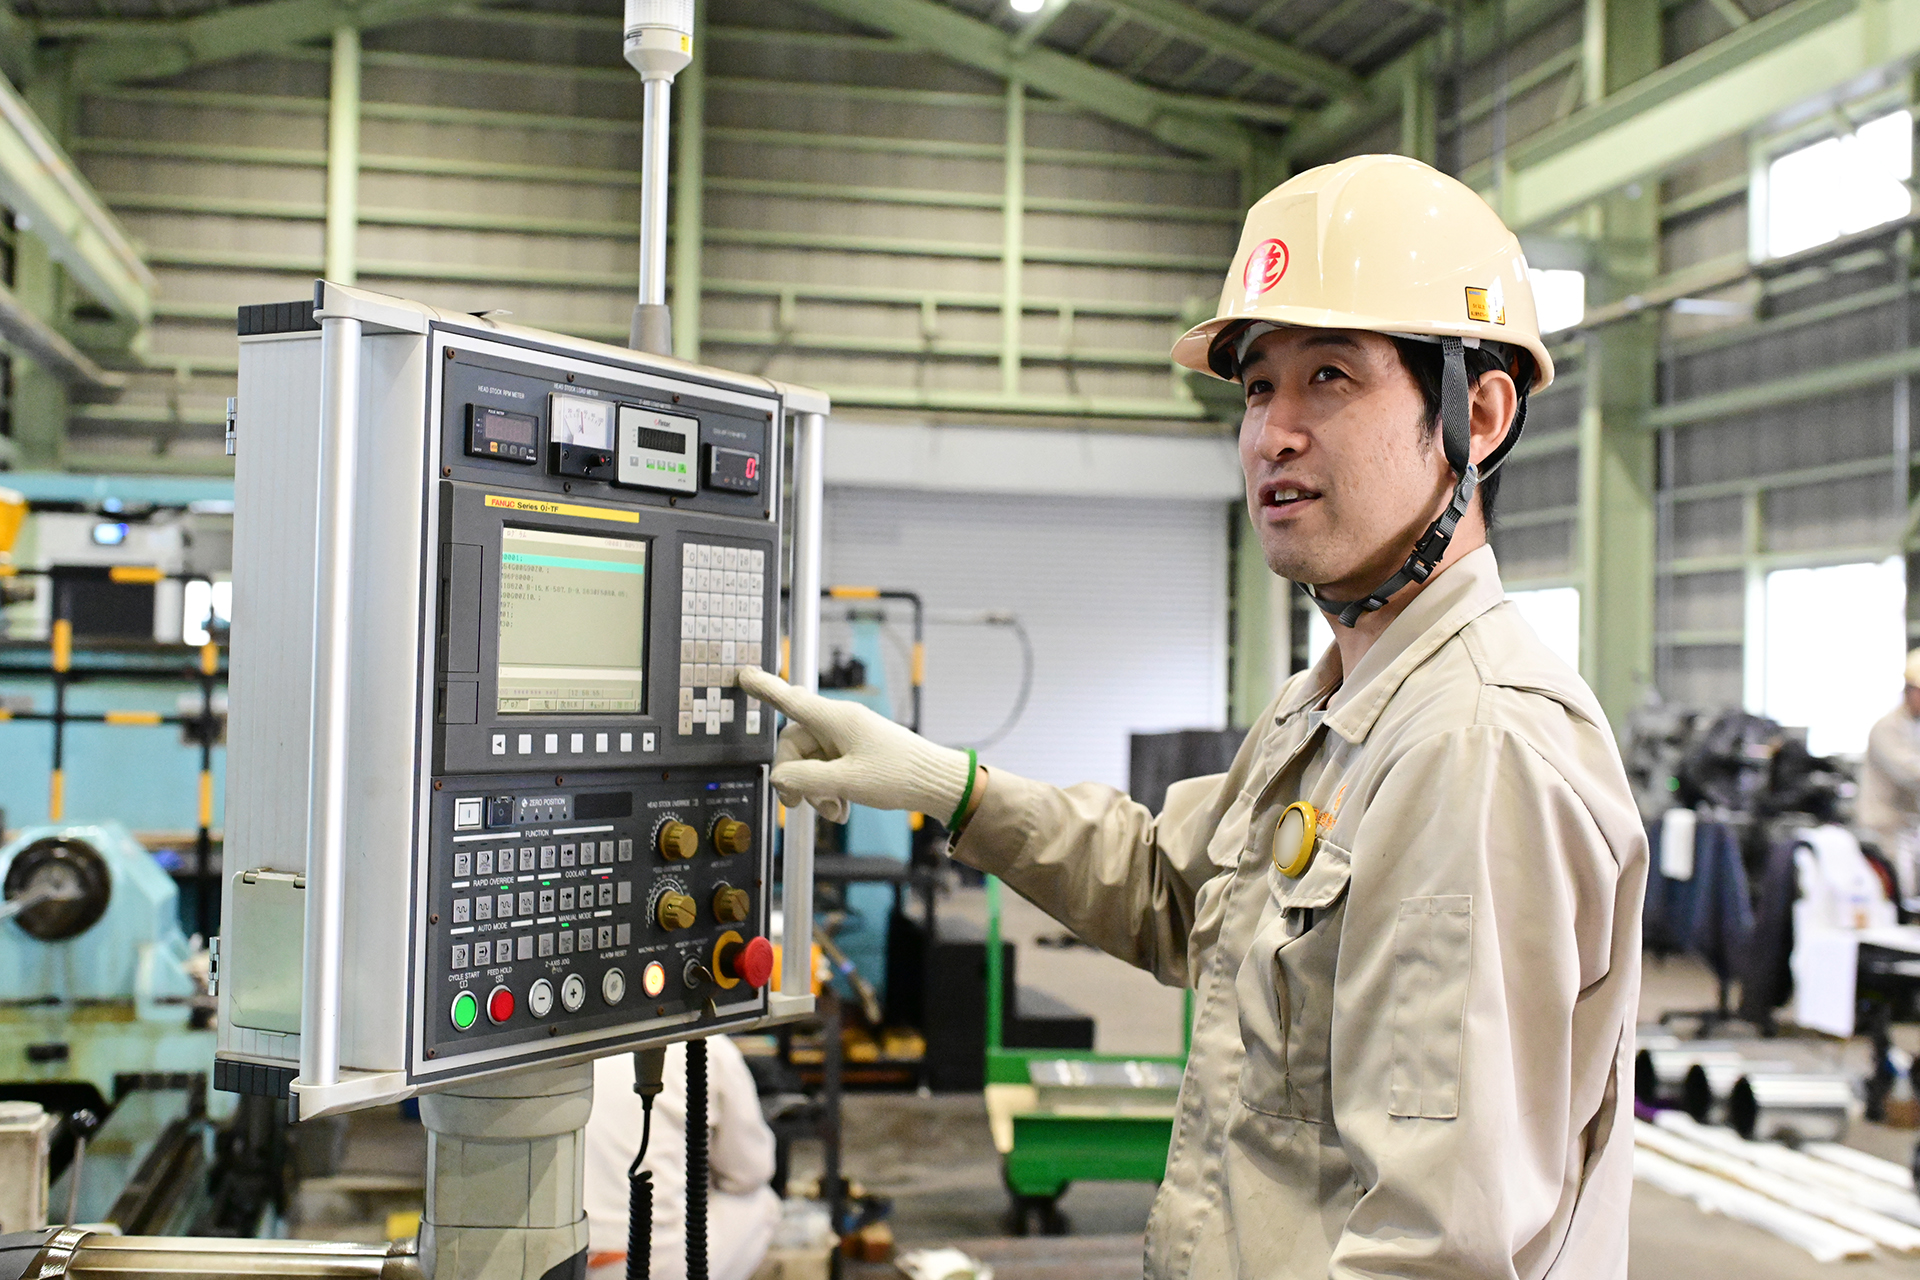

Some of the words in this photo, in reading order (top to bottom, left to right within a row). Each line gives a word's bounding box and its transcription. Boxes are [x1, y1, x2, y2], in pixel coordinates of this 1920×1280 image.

[478, 385, 489, 393] HEAD
[489, 387, 502, 395] STOCK
[745, 458, 756, 479] 0
[491, 498, 515, 508] FANUC
[517, 502, 538, 510] Series
[529, 798, 542, 807] ZERO
[543, 797, 566, 806] POSITION
[525, 829, 549, 838] FUNCTION
[565, 870, 587, 878] COOLANT
[489, 876, 514, 886] OVERRIDE
[558, 914, 578, 922] MANUAL
[478, 924, 492, 932] AUTO
[493, 922, 508, 930] MODE
[560, 957, 570, 965] JOG
[448, 973, 464, 982] CYCLE
[465, 971, 480, 980] START
